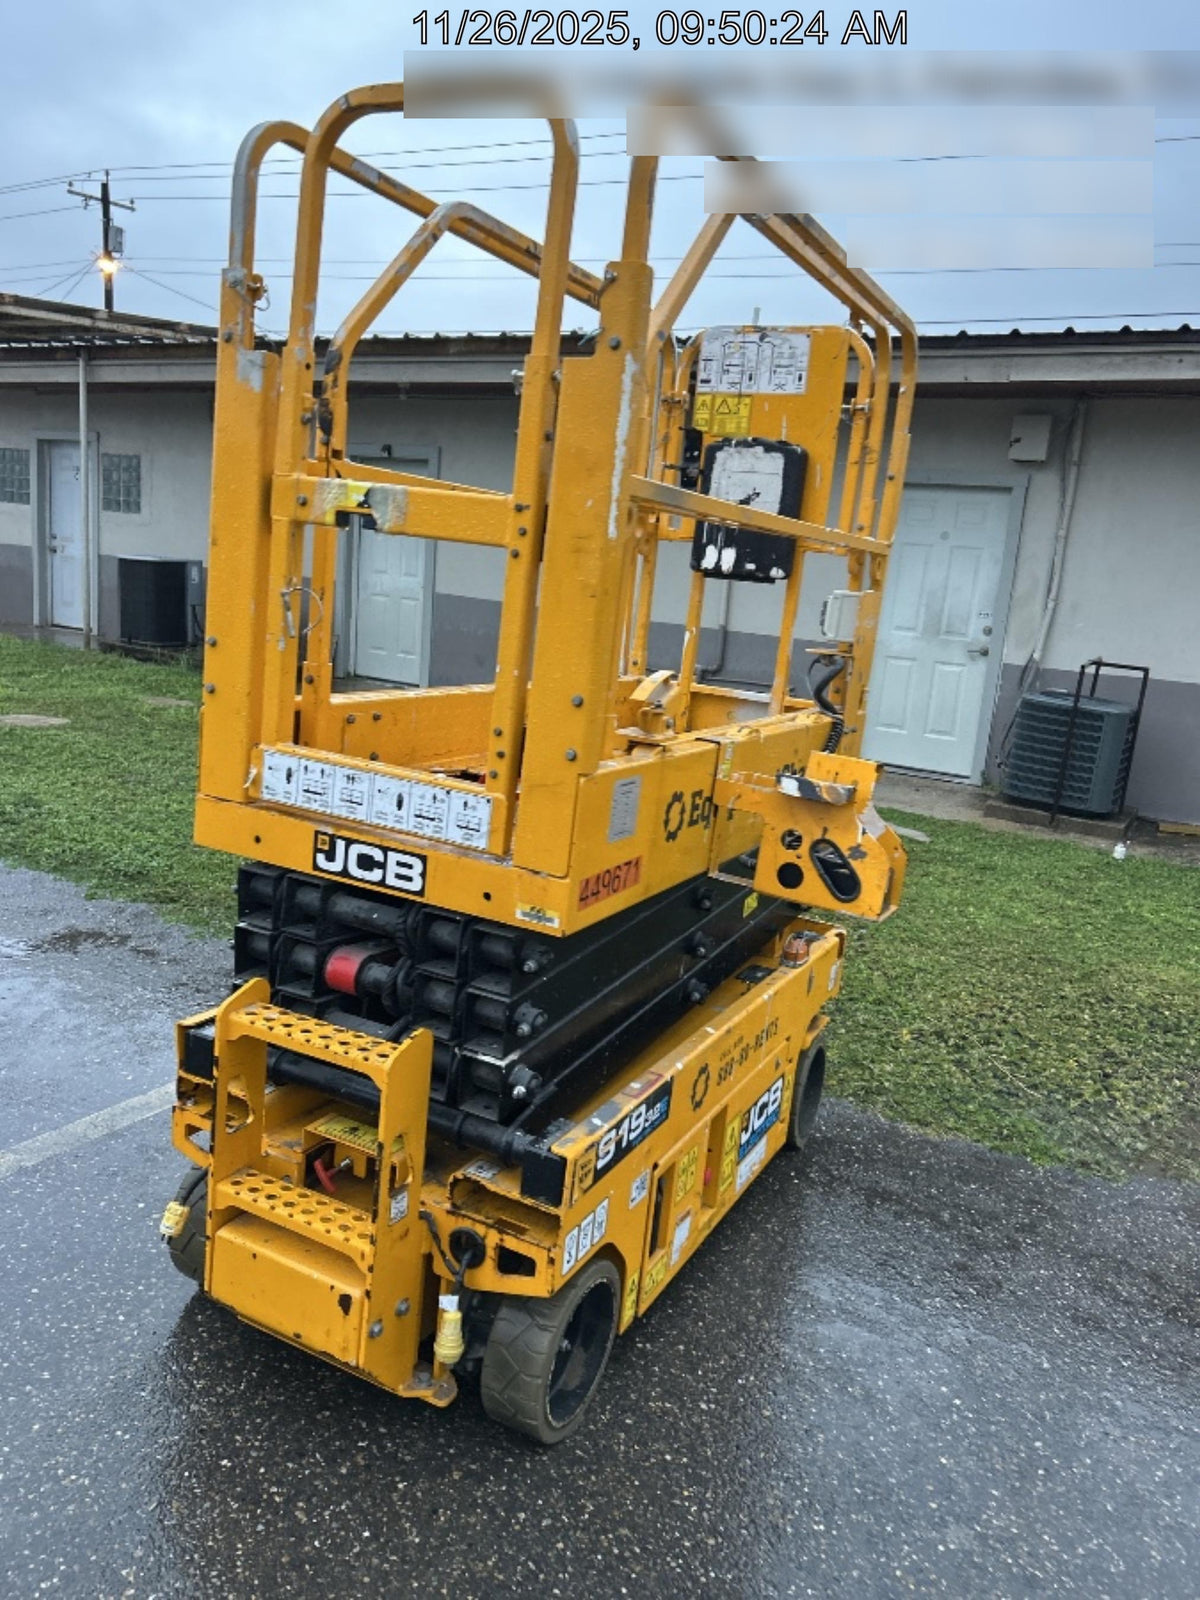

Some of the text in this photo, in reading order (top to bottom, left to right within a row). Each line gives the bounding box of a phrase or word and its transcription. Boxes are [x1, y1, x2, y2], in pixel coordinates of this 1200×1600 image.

[316, 838, 424, 892] JCB
[578, 856, 640, 903] 449671
[741, 1077, 783, 1145] JCB
